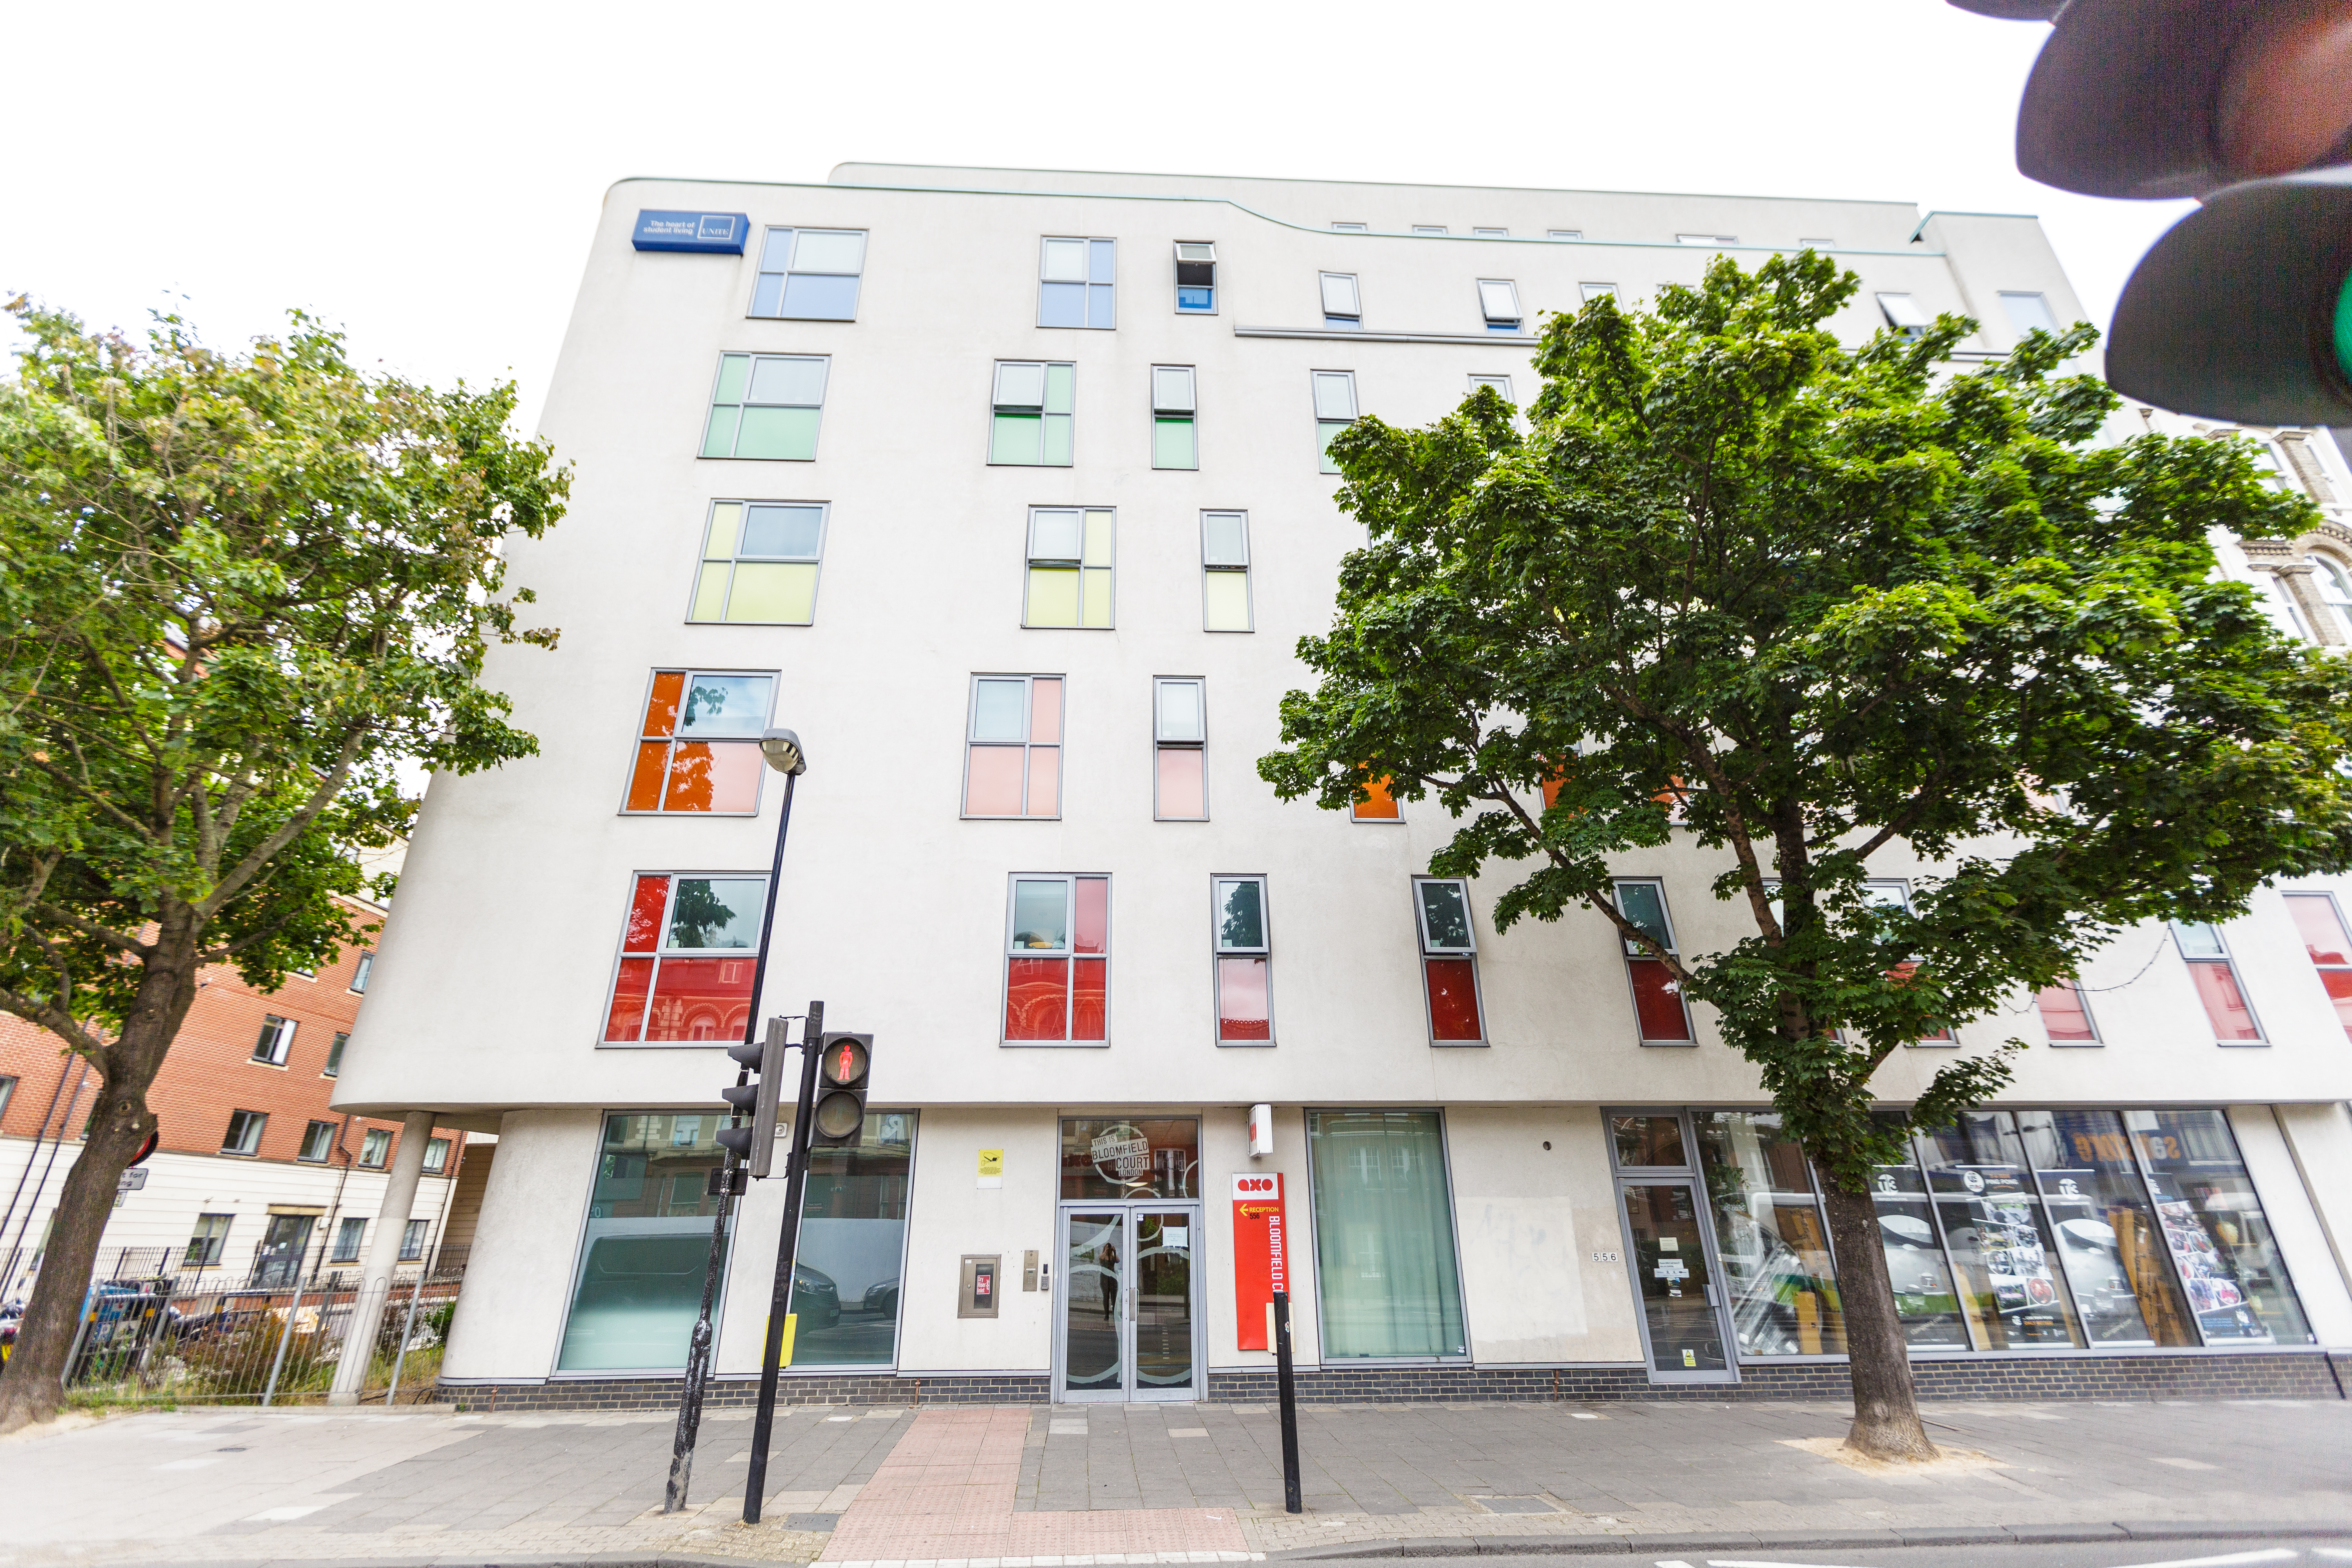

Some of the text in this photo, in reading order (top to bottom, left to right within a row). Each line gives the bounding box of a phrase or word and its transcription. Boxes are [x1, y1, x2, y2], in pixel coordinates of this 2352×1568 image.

[702, 227, 729, 236] UNITE
[1093, 1137, 1107, 1147] THIS
[1091, 1140, 1148, 1160] BLOOMFIELD
[1116, 1156, 1149, 1169] COURT
[1269, 1215, 1283, 1280] BLOOMFIELD
